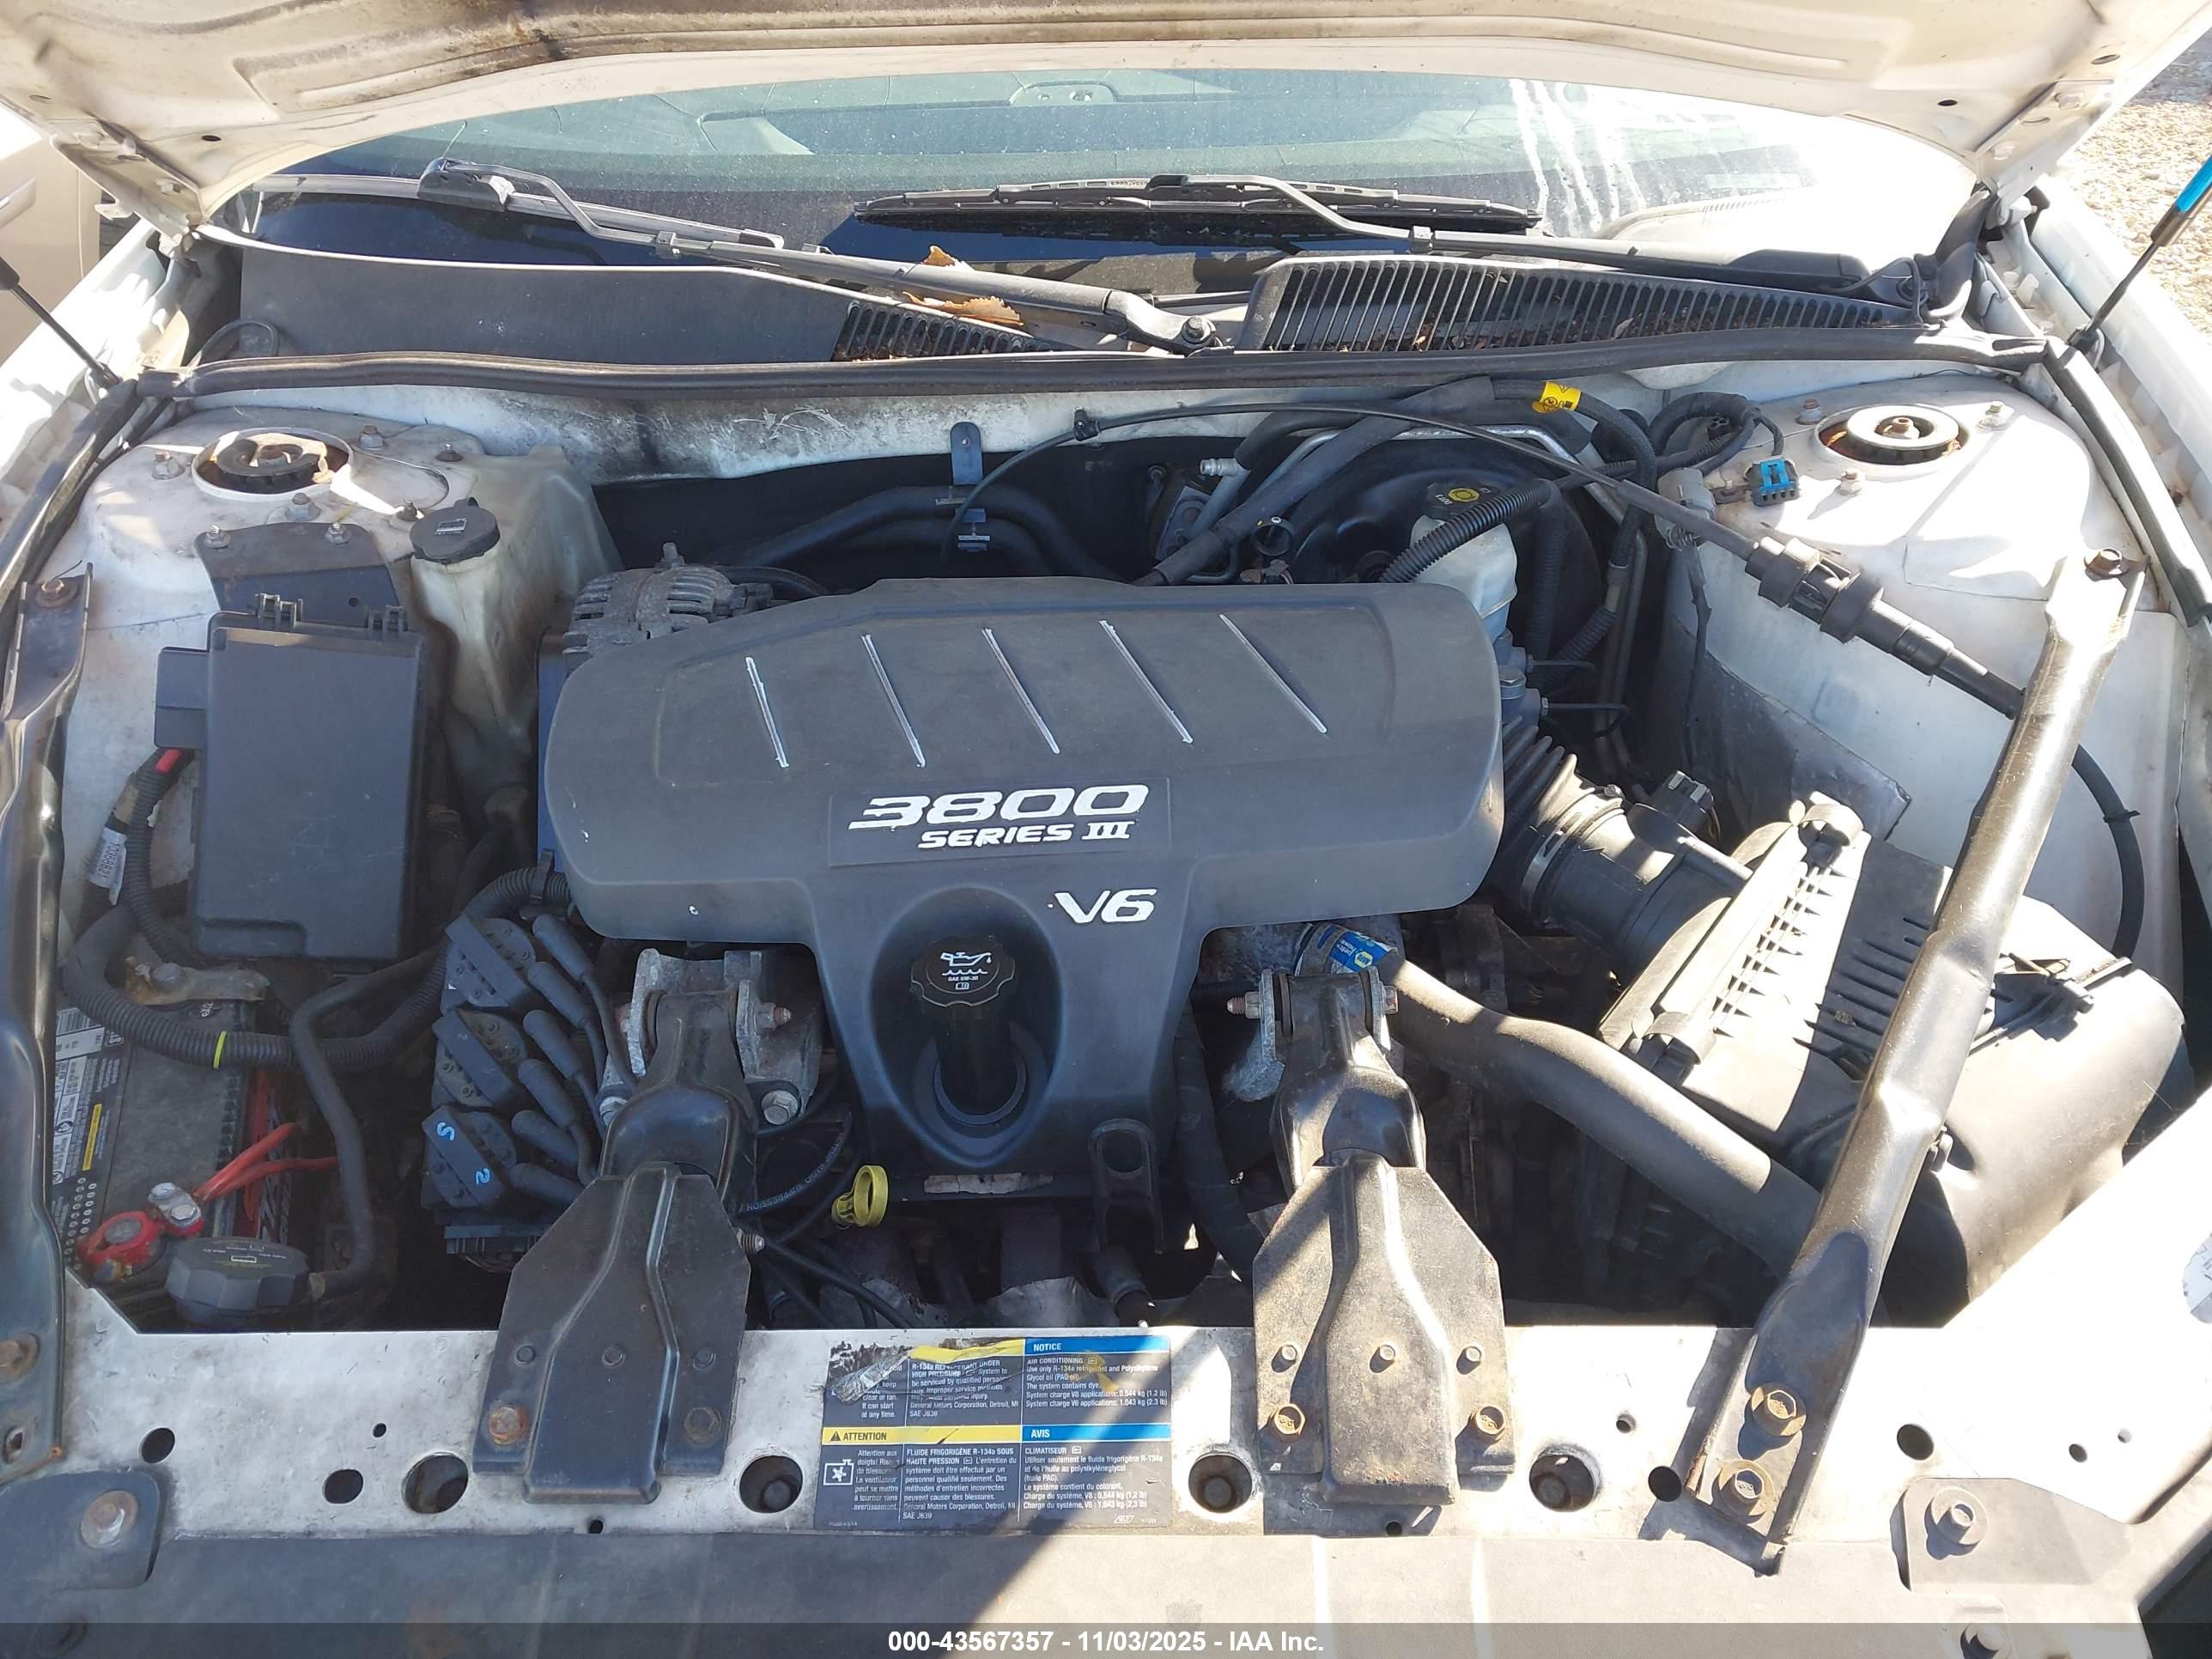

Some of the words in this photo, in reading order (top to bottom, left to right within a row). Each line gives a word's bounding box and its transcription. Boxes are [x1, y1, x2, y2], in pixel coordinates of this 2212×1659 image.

[848, 784, 1149, 830] 3800
[918, 823, 1075, 848] SERIES
[1081, 820, 1135, 841] III
[1054, 888, 1158, 924] V6
[1033, 1343, 1062, 1352] NOTICE
[921, 1378, 945, 1387] serviced
[947, 1377, 955, 1386] by
[956, 1376, 981, 1385] qualified
[1137, 1389, 1146, 1398] kg
[953, 1401, 988, 1410] Corporation,
[1080, 1399, 1118, 1407] applications:
[1137, 1398, 1146, 1407] kg
[842, 1432, 887, 1441] ATTENTION
[1030, 1429, 1050, 1437] AVIS
[930, 1447, 972, 1456] FRIGORIGÈNE
[857, 1458, 877, 1467] doigts!
[1106, 1455, 1139, 1464] frigorigène
[905, 1466, 931, 1475] système
[985, 1467, 996, 1475] par
[1070, 1465, 1127, 1474] polyalkylèneglycol
[936, 1475, 959, 1484] qualifié
[1042, 1474, 1058, 1483] PAG).
[1032, 1483, 1059, 1492] système
[903, 1494, 928, 1504] peuvent
[1115, 1492, 1125, 1500] kg
[948, 1503, 984, 1511] Corporation,
[1056, 1501, 1084, 1510] système,
[1139, 1500, 1148, 1509] lb)
